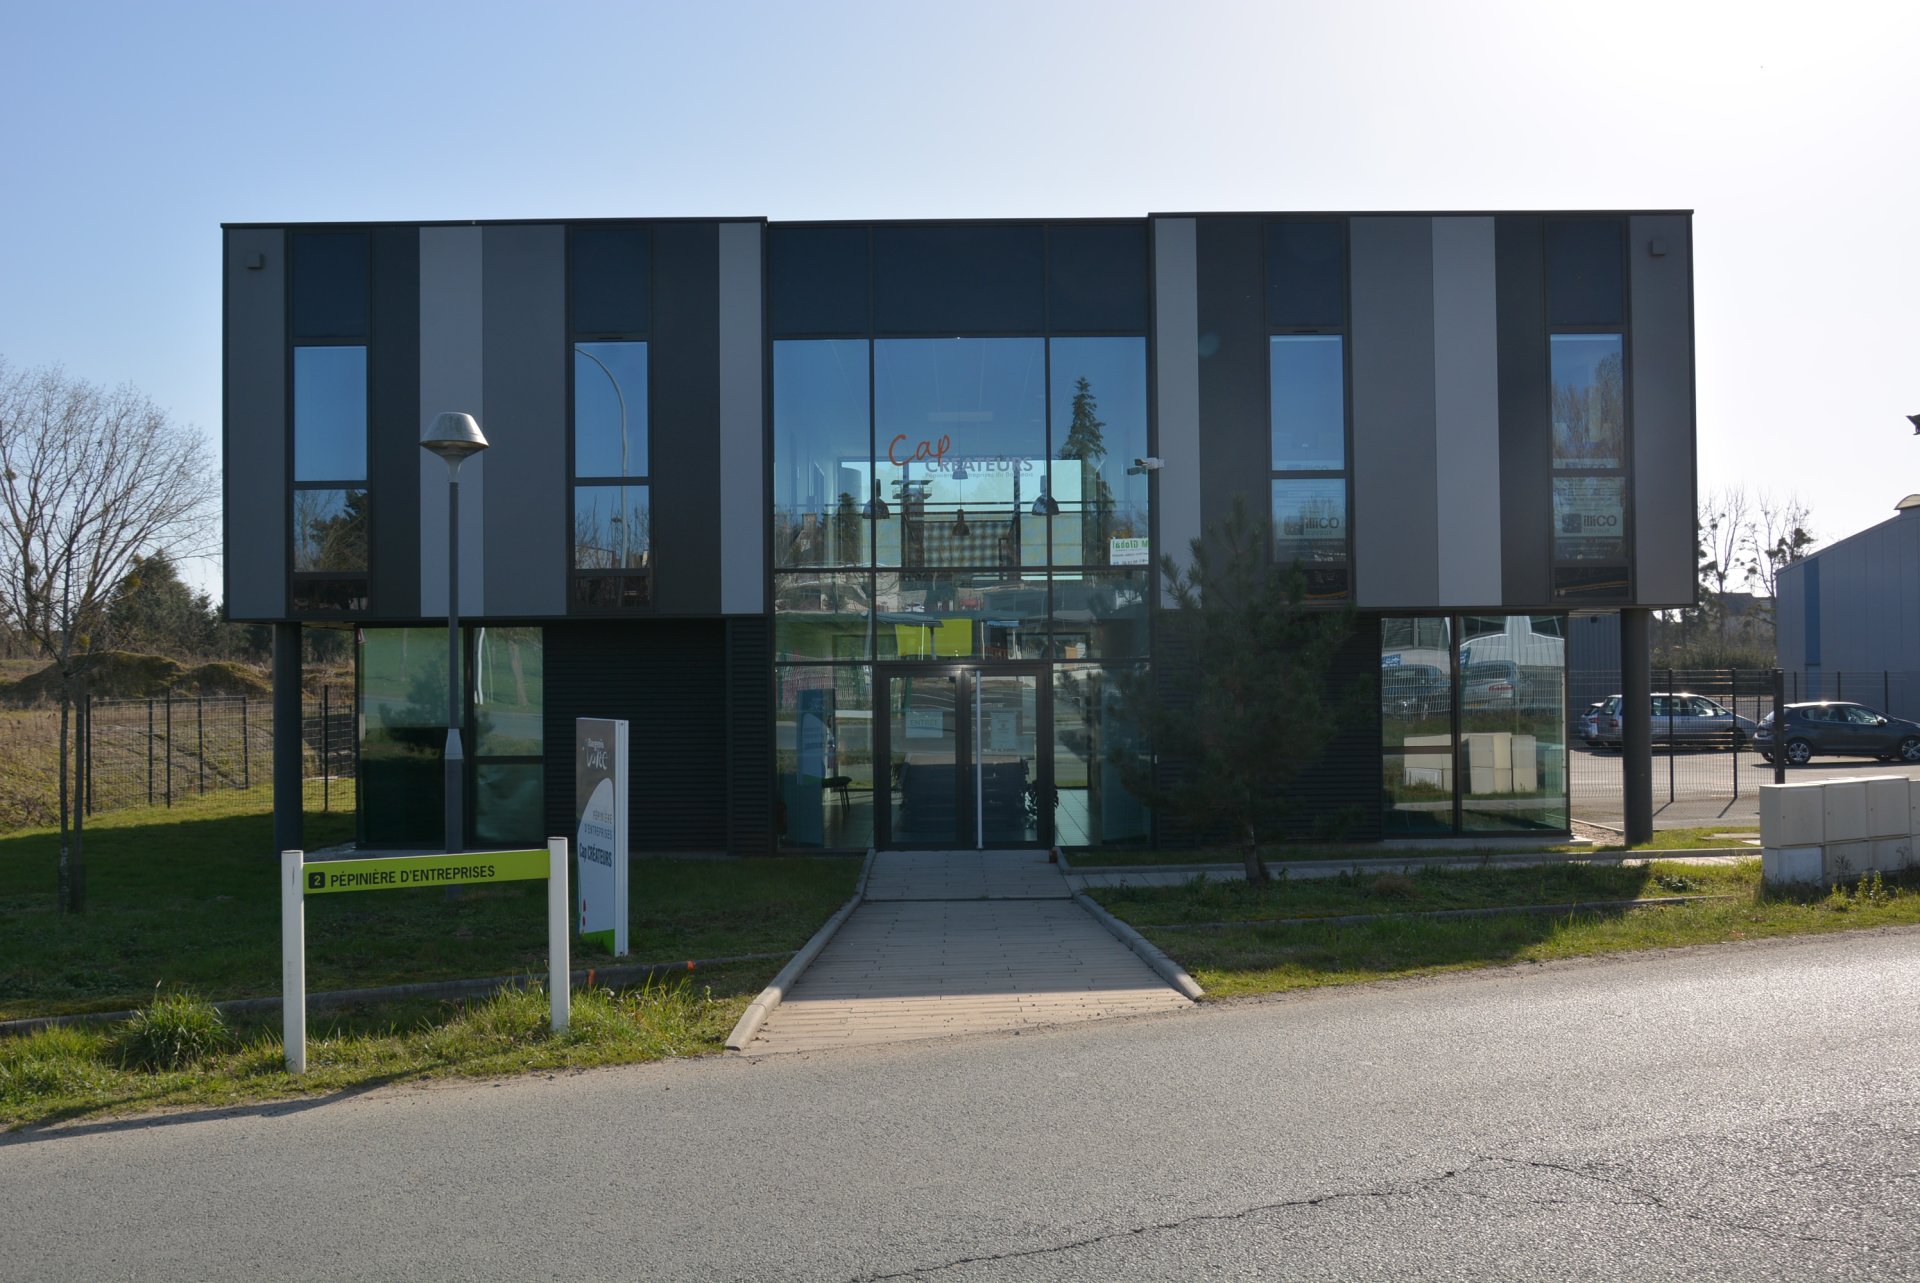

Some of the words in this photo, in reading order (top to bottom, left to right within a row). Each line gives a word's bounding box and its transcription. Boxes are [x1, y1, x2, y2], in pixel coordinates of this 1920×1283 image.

[889, 434, 950, 467] Cap
[925, 453, 1033, 473] CRÉATEURS
[910, 718, 939, 726] ENTRÉE
[592, 808, 613, 825] PÉPINIÈRE
[584, 823, 613, 840] D'ENTREPRISES
[579, 842, 587, 862] Cap
[587, 843, 612, 867] CRÉATEURS
[313, 875, 321, 886] 2
[330, 869, 396, 888] PÉPINIÈRE
[400, 865, 495, 883] D'ENTREPRISES
